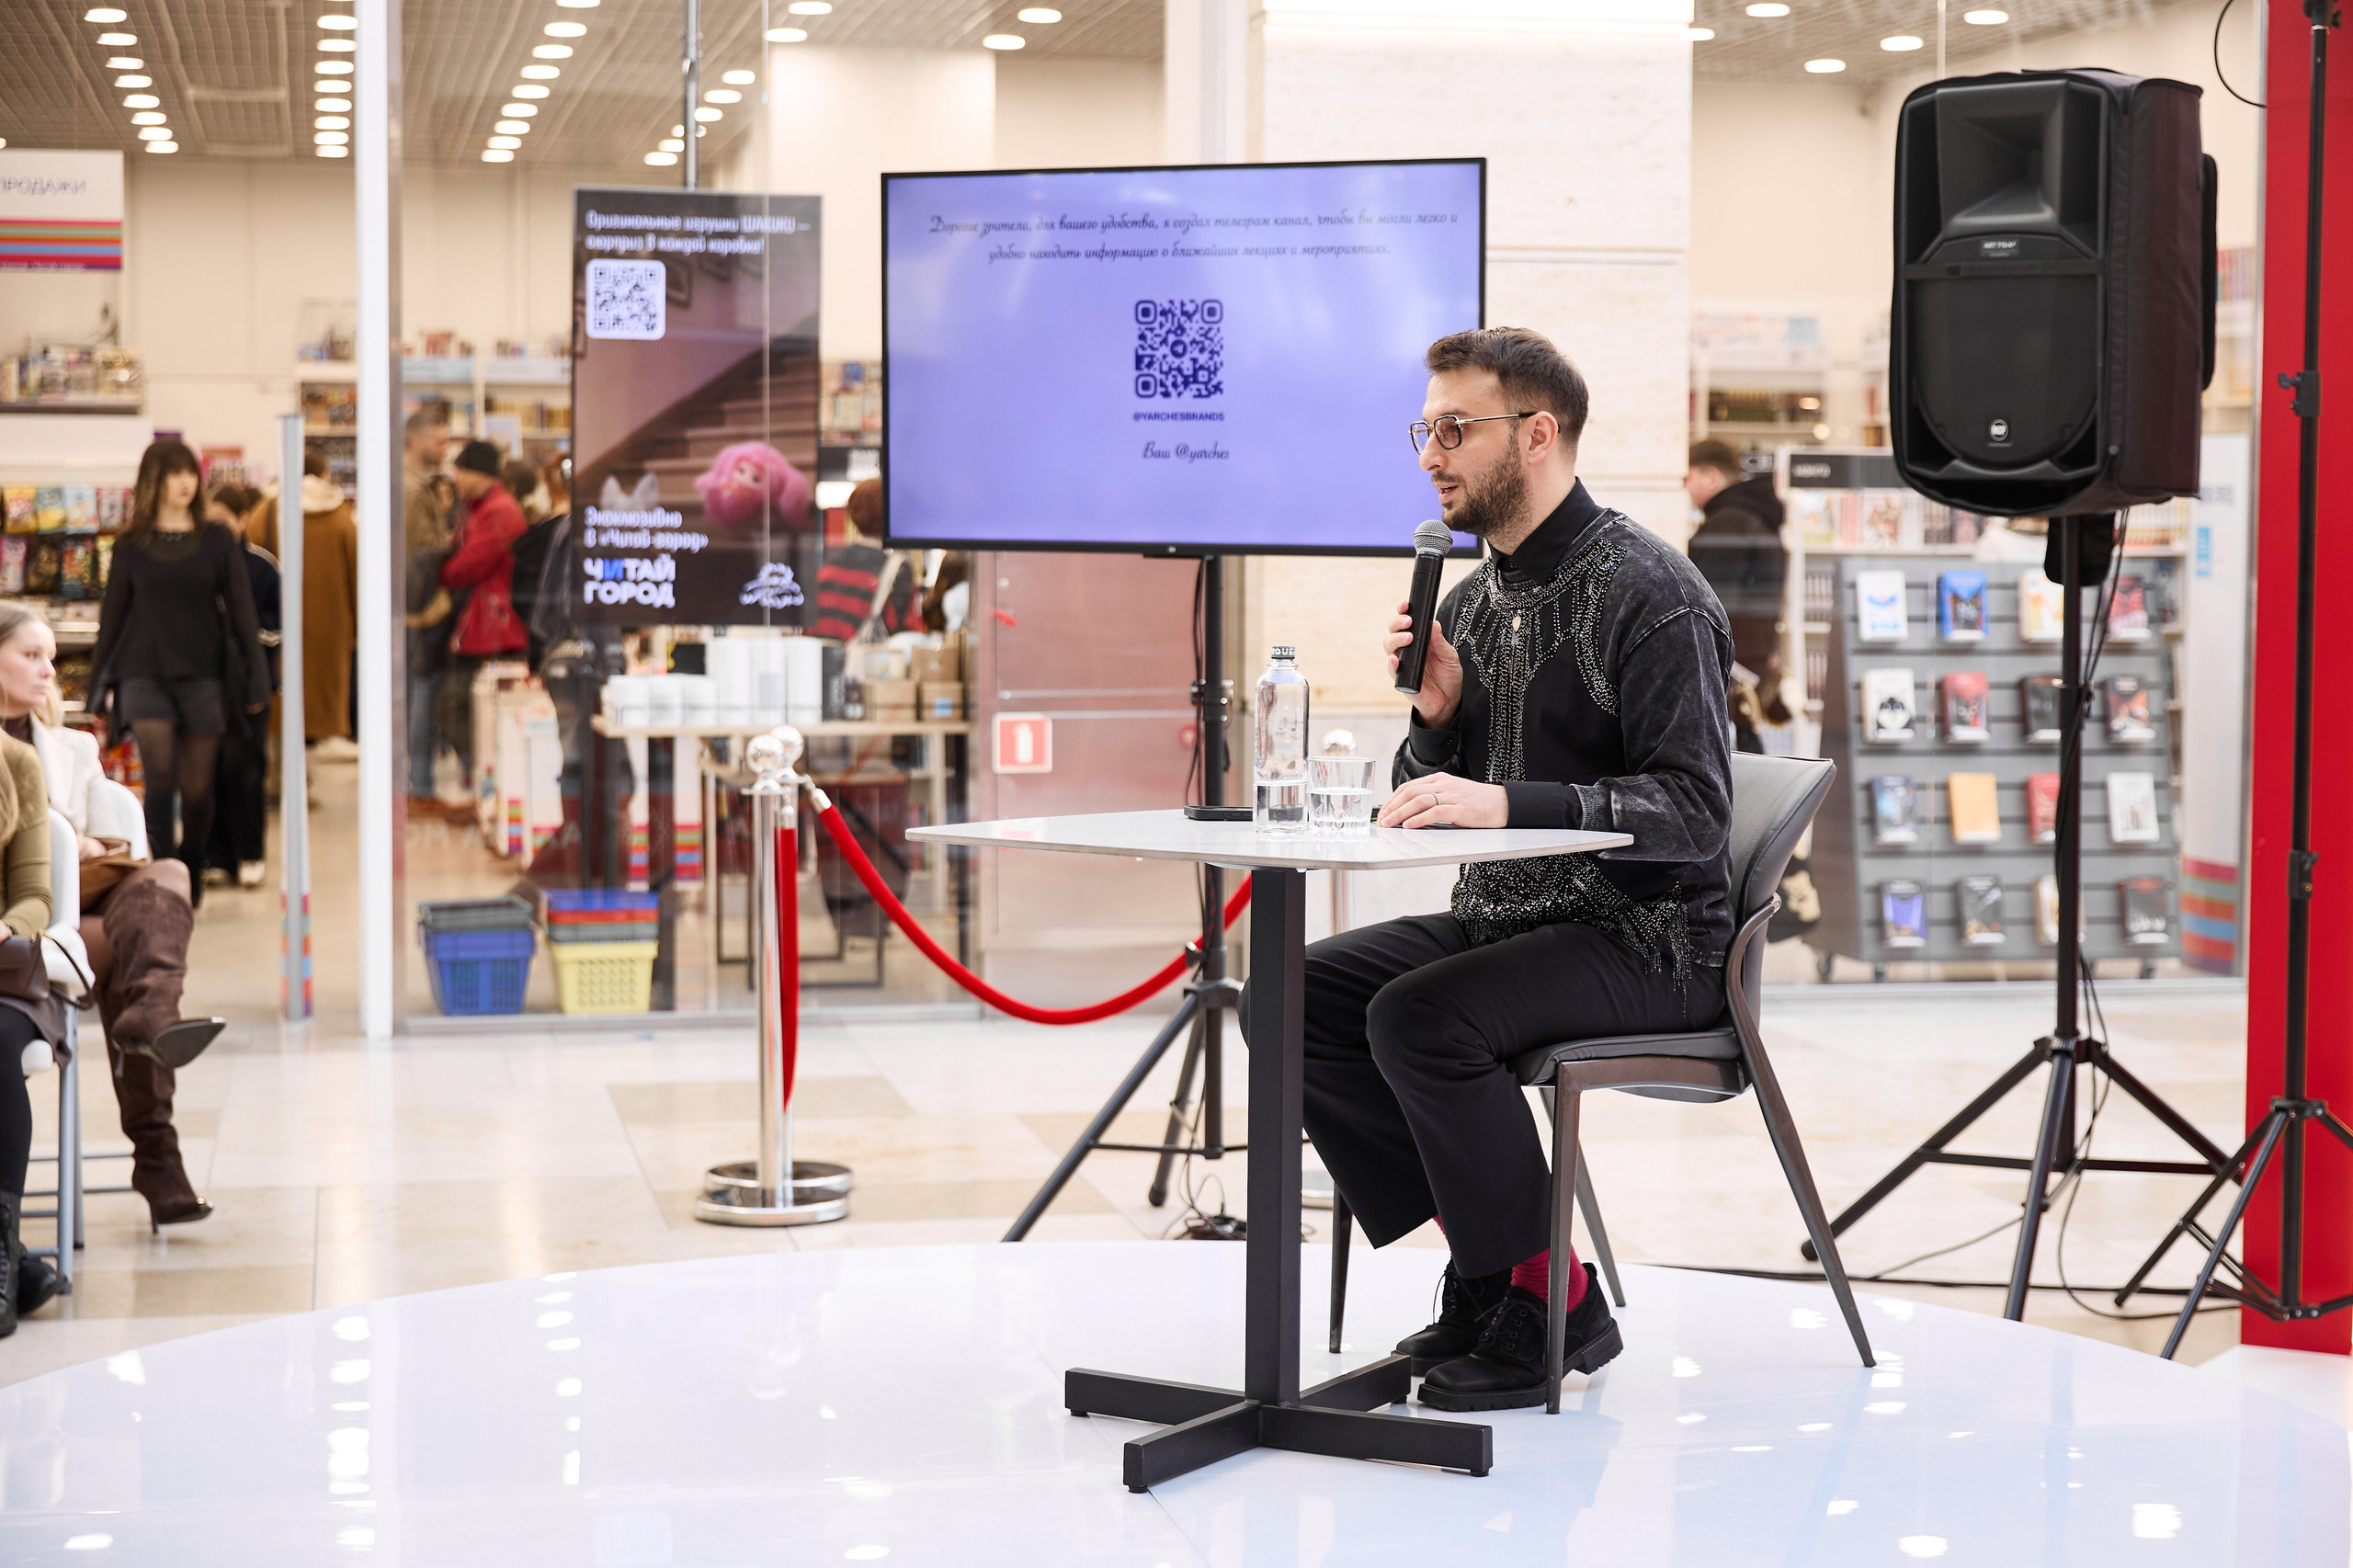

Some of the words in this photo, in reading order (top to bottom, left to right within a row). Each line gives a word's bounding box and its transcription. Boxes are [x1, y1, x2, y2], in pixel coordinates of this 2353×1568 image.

[930, 215, 979, 235] Дорогие
[982, 222, 1032, 238] зрители,
[1036, 215, 1056, 231] для
[1059, 214, 1097, 231] вашего
[1101, 212, 1159, 234] удобства,
[1163, 219, 1170, 229] я
[1173, 213, 1211, 234] создал
[1214, 217, 1270, 231] телеграм
[1274, 216, 1313, 229] канал,
[1317, 209, 1354, 225] чтобы
[1358, 208, 1373, 225] вы
[1377, 213, 1412, 226] могли
[1416, 212, 1447, 226] легко
[1450, 212, 1459, 224] и
[988, 244, 1027, 264] удобно
[1029, 244, 1082, 260] находить
[1085, 243, 1159, 262] информацию
[1162, 247, 1169, 258] о
[1172, 241, 1239, 258] ближайших
[1243, 246, 1287, 260] лекциях
[1290, 245, 1298, 256] и
[1302, 244, 1391, 259] мероприятиях.
[1133, 412, 1225, 422] @YARCHESBRANDS
[1142, 440, 1171, 460] Ваш
[1176, 441, 1230, 463] @yarches
[584, 506, 682, 528] Эксклюзивно
[584, 552, 676, 582] ЧИТАЙ
[584, 581, 676, 608] ГОРОД
